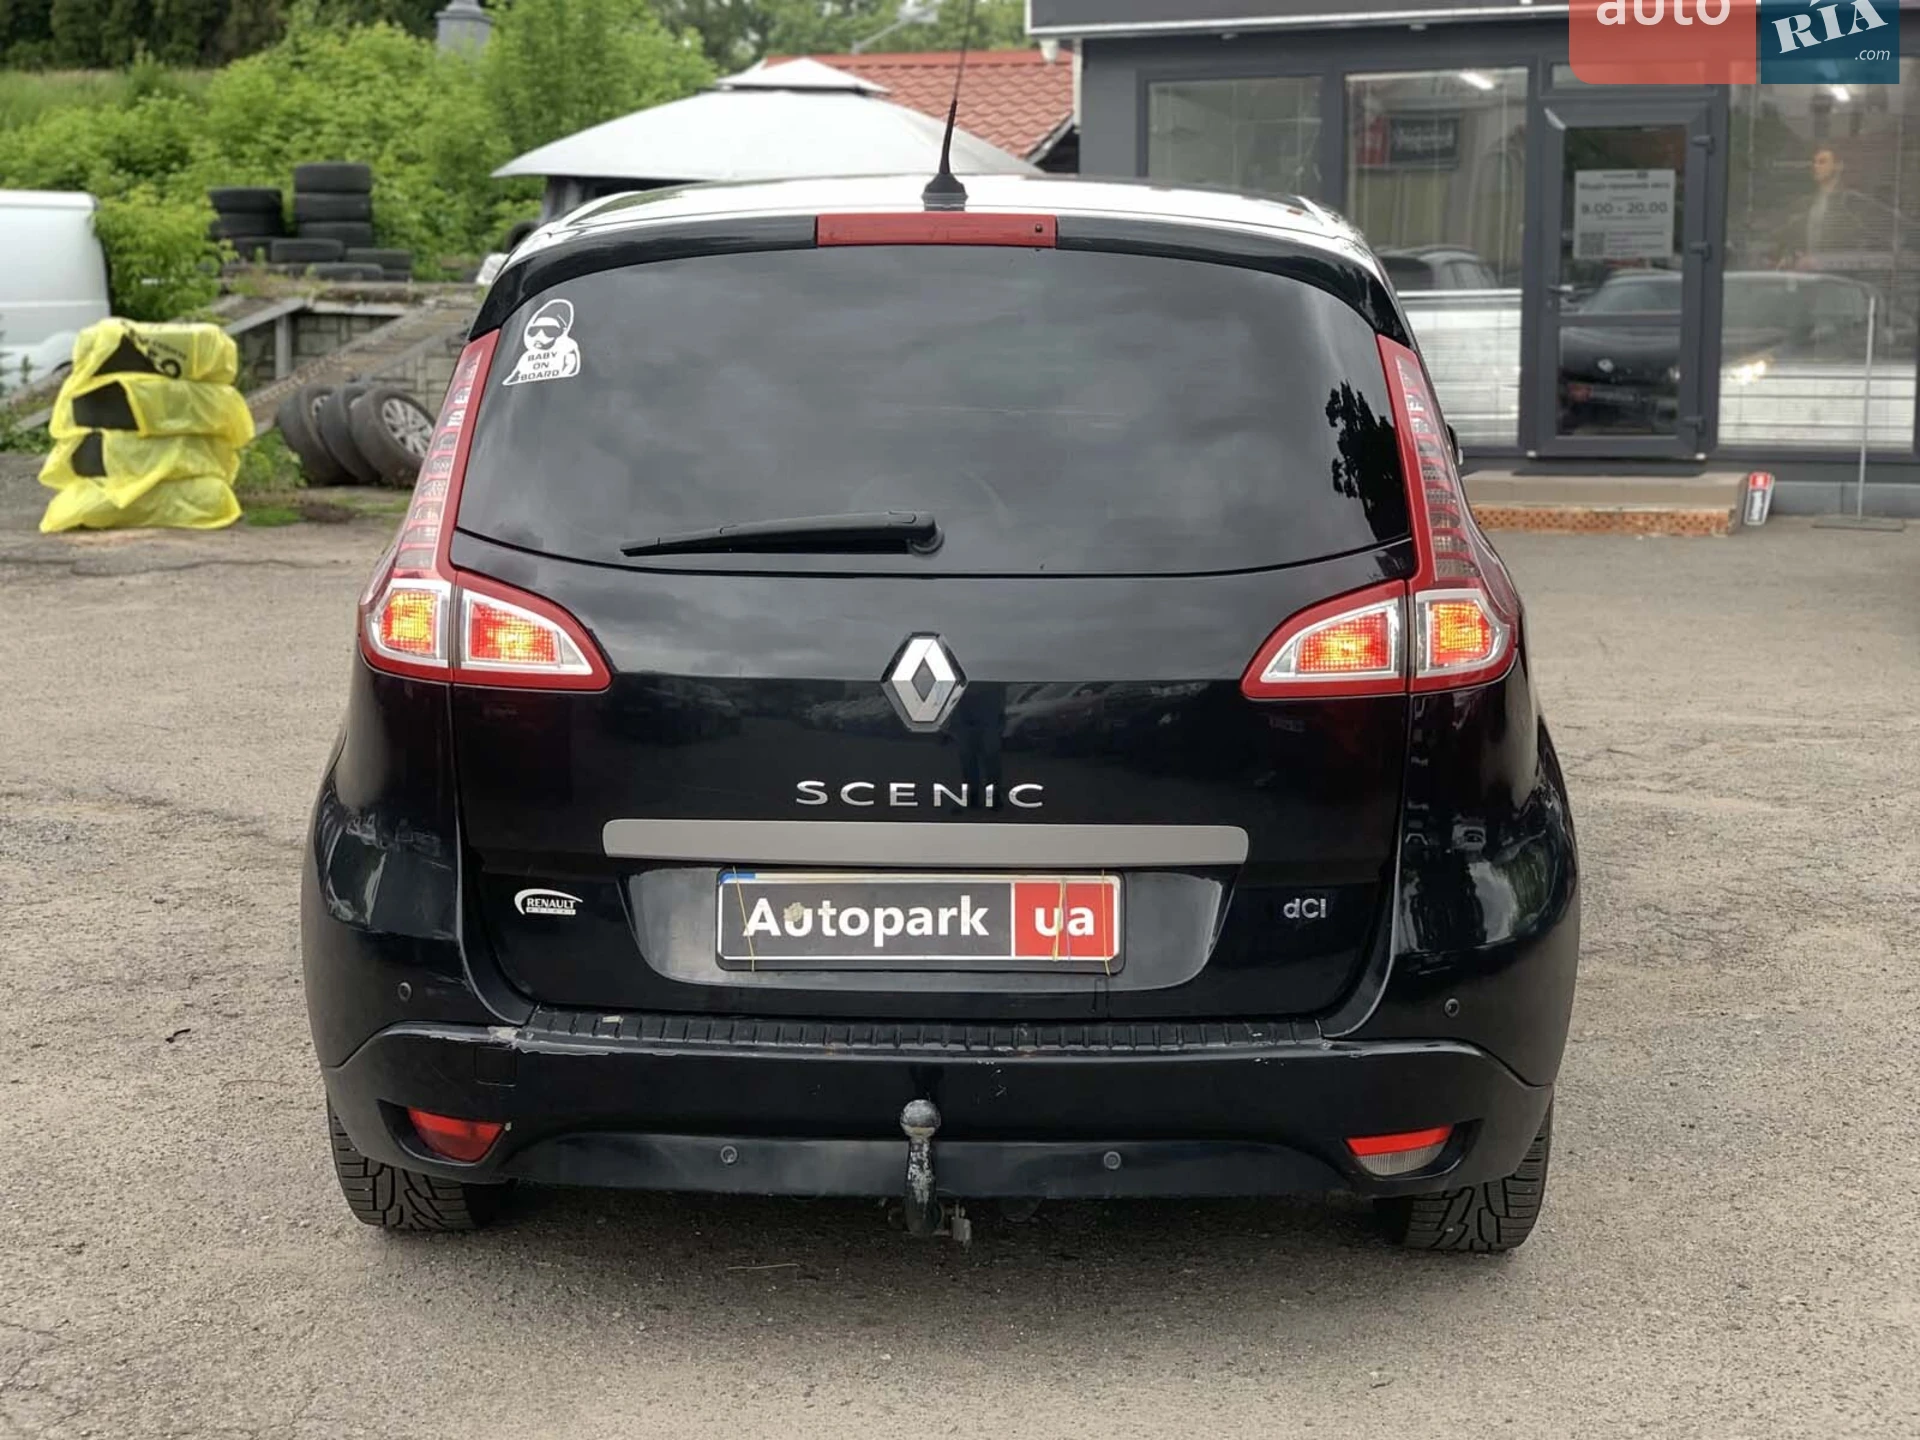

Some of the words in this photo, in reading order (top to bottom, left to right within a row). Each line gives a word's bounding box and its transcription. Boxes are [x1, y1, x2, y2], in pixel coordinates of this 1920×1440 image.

[1627, 201, 1668, 214] 20.00
[527, 352, 558, 362] BABY
[533, 362, 550, 371] ON
[521, 370, 560, 381] BOARD
[796, 780, 1044, 809] SCENIC
[526, 897, 577, 909] RENAULT
[742, 895, 990, 947] Autopark
[1034, 906, 1095, 937] ua
